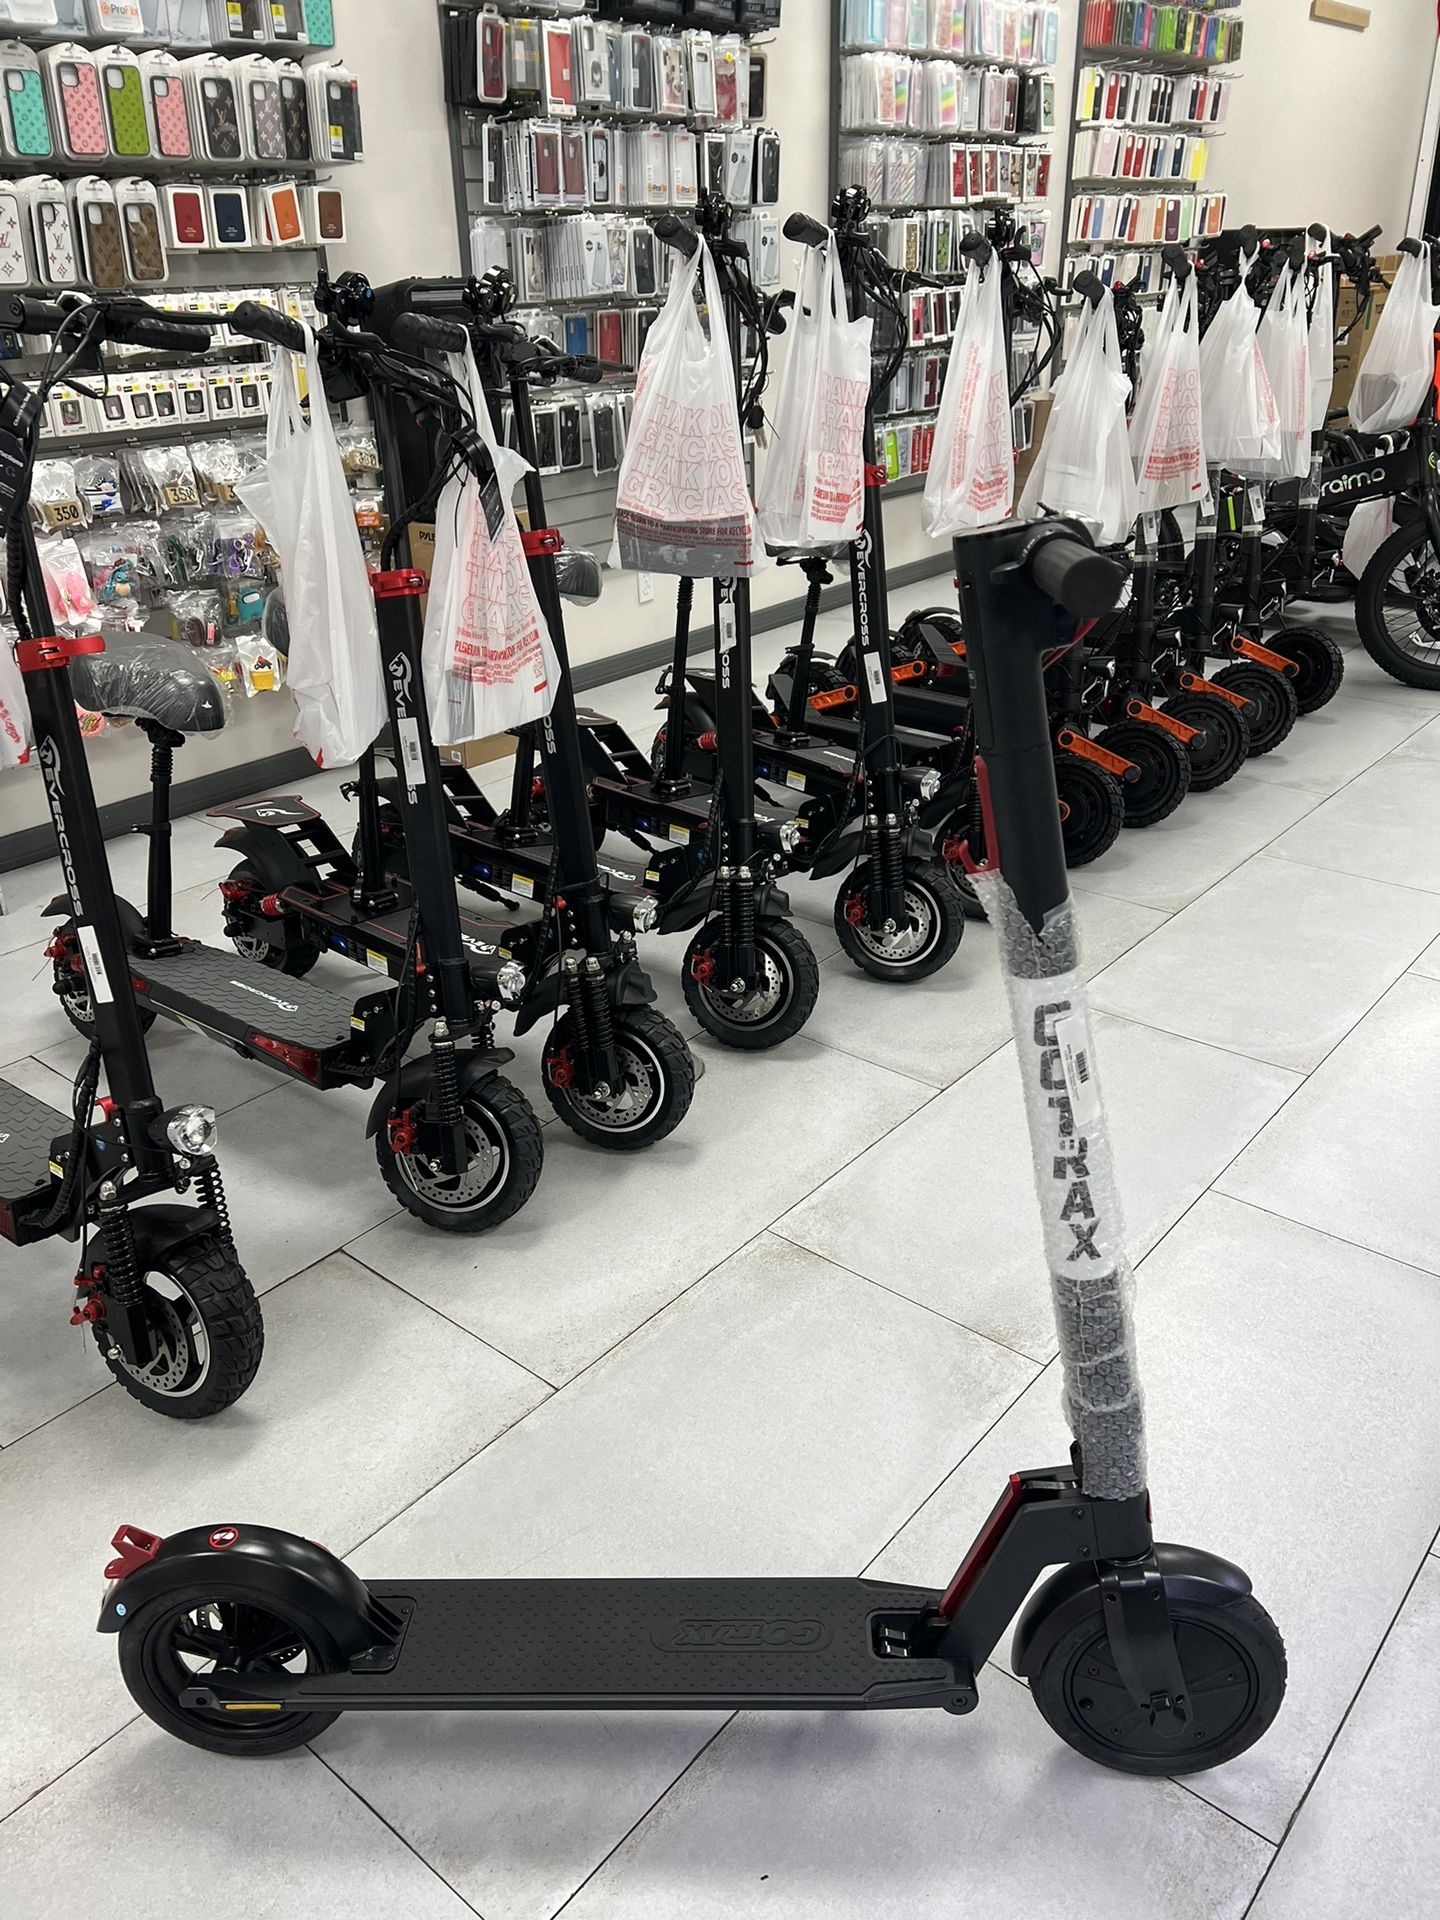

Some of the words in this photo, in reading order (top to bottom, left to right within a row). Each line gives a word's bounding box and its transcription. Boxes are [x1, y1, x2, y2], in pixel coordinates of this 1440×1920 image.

[54, 504, 79, 522] 350
[856, 550, 870, 647] EVERCROSS
[44, 767, 84, 918] EVERCROSS
